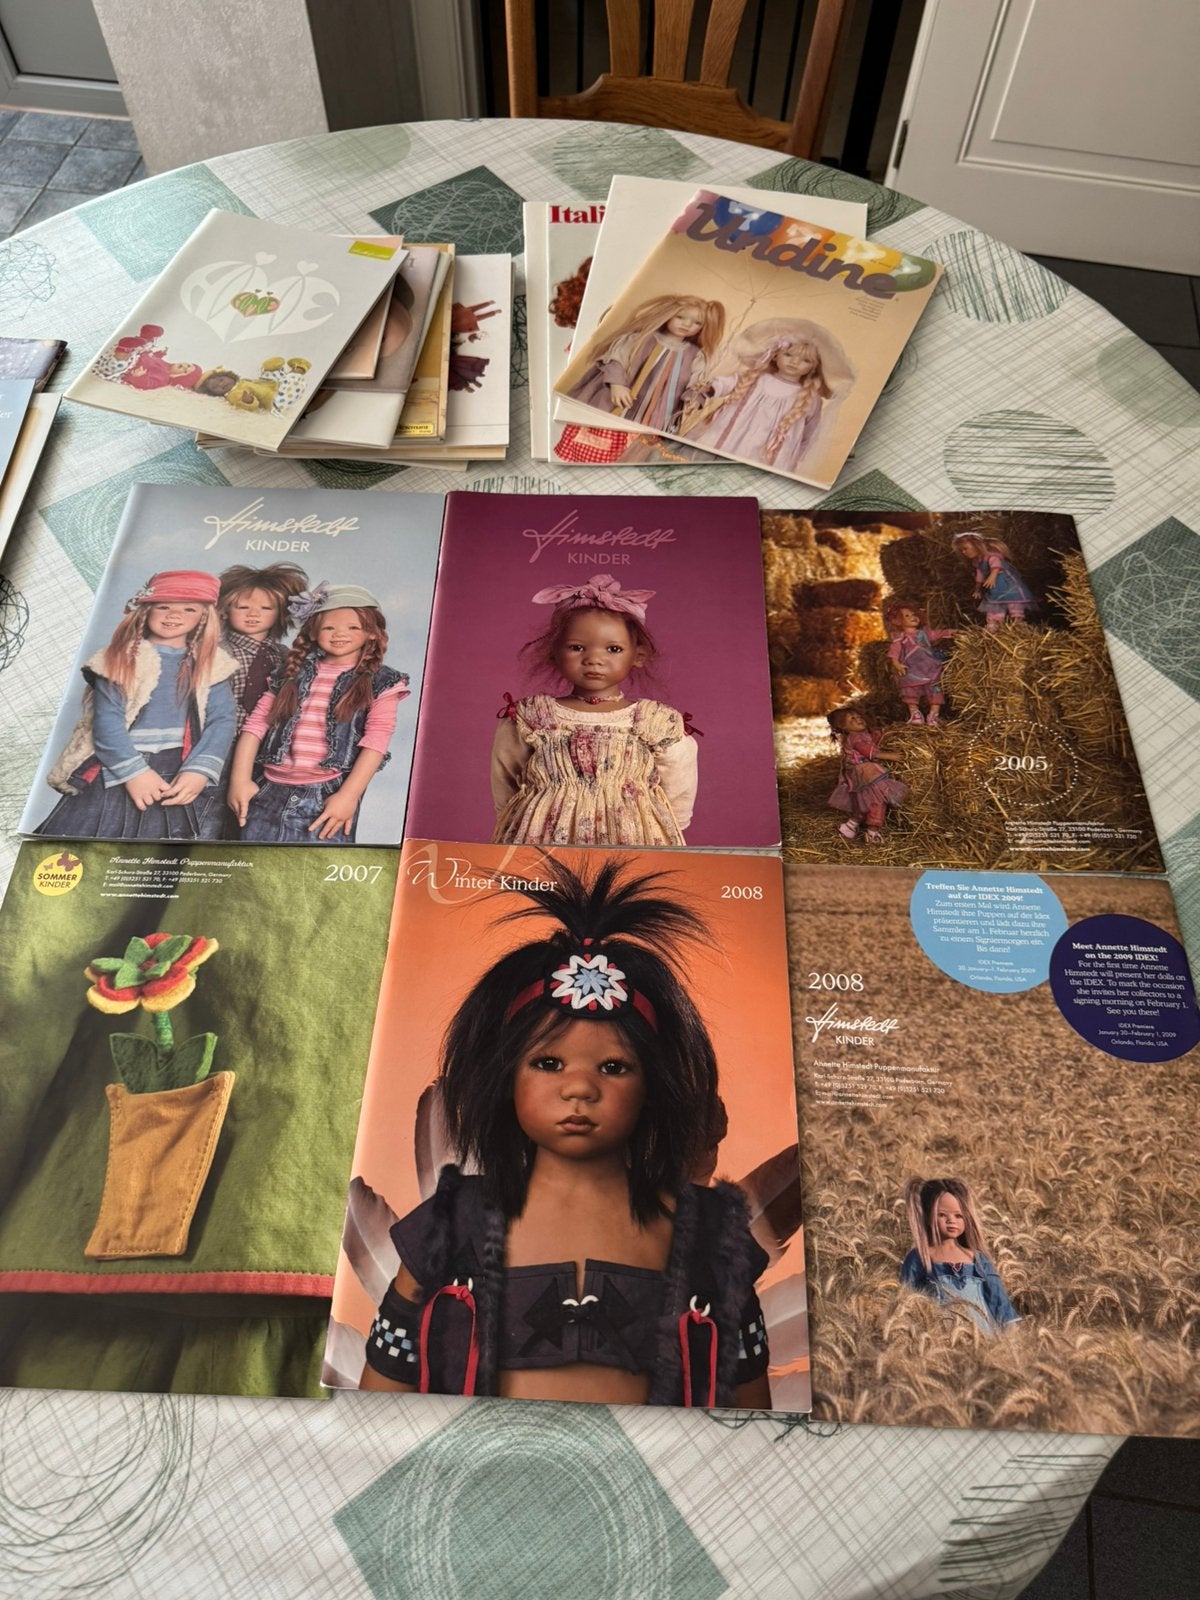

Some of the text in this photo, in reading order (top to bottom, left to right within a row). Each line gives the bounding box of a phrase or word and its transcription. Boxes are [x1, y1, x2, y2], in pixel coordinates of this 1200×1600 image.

[686, 202, 899, 300] Undine
[204, 497, 360, 550] Himstedt
[522, 509, 676, 563] Himstedt
[245, 540, 310, 552] KINDER
[568, 553, 631, 565] KINDER
[994, 756, 1048, 771] 2005
[109, 856, 141, 864] Annette
[142, 857, 179, 865] Himstedt
[37, 873, 77, 881] SOMMER
[324, 864, 383, 884] 2007
[407, 858, 558, 891] Winter Kinder
[721, 885, 763, 900] 2008
[1006, 886, 1044, 894] Himstedt
[926, 908, 960, 916] Himstedt
[977, 910, 1007, 919] Puppen
[932, 926, 966, 934] Sammler
[990, 928, 1019, 936] Februar
[1072, 942, 1168, 953] Meet Annette Himstedt
[1098, 952, 1112, 960] the
[1114, 953, 1134, 961] 2009
[1078, 960, 1092, 968] For
[1106, 961, 1121, 969] first
[1122, 962, 1139, 970] time
[1140, 962, 1169, 971] Annette
[1064, 968, 1099, 977] Himstedt
[1157, 972, 1175, 980] dolls
[808, 972, 864, 992] 2008
[1070, 978, 1083, 986] the
[1118, 980, 1138, 988] mark
[1139, 981, 1152, 989] the
[1152, 982, 1186, 990] occasion
[1091, 988, 1116, 996] invites
[1130, 990, 1167, 998] collectors
[1073, 996, 1101, 1006] signing
[1102, 998, 1135, 1007] morning
[1146, 999, 1181, 1010] February
[1106, 1006, 1160, 1017] See you there!
[805, 1002, 900, 1043] Himstedt
[835, 1035, 876, 1046] KINDER
[813, 1060, 940, 1073] Annette Himstedt Puppenmanufaktur
[926, 1078, 953, 1088] Germany
